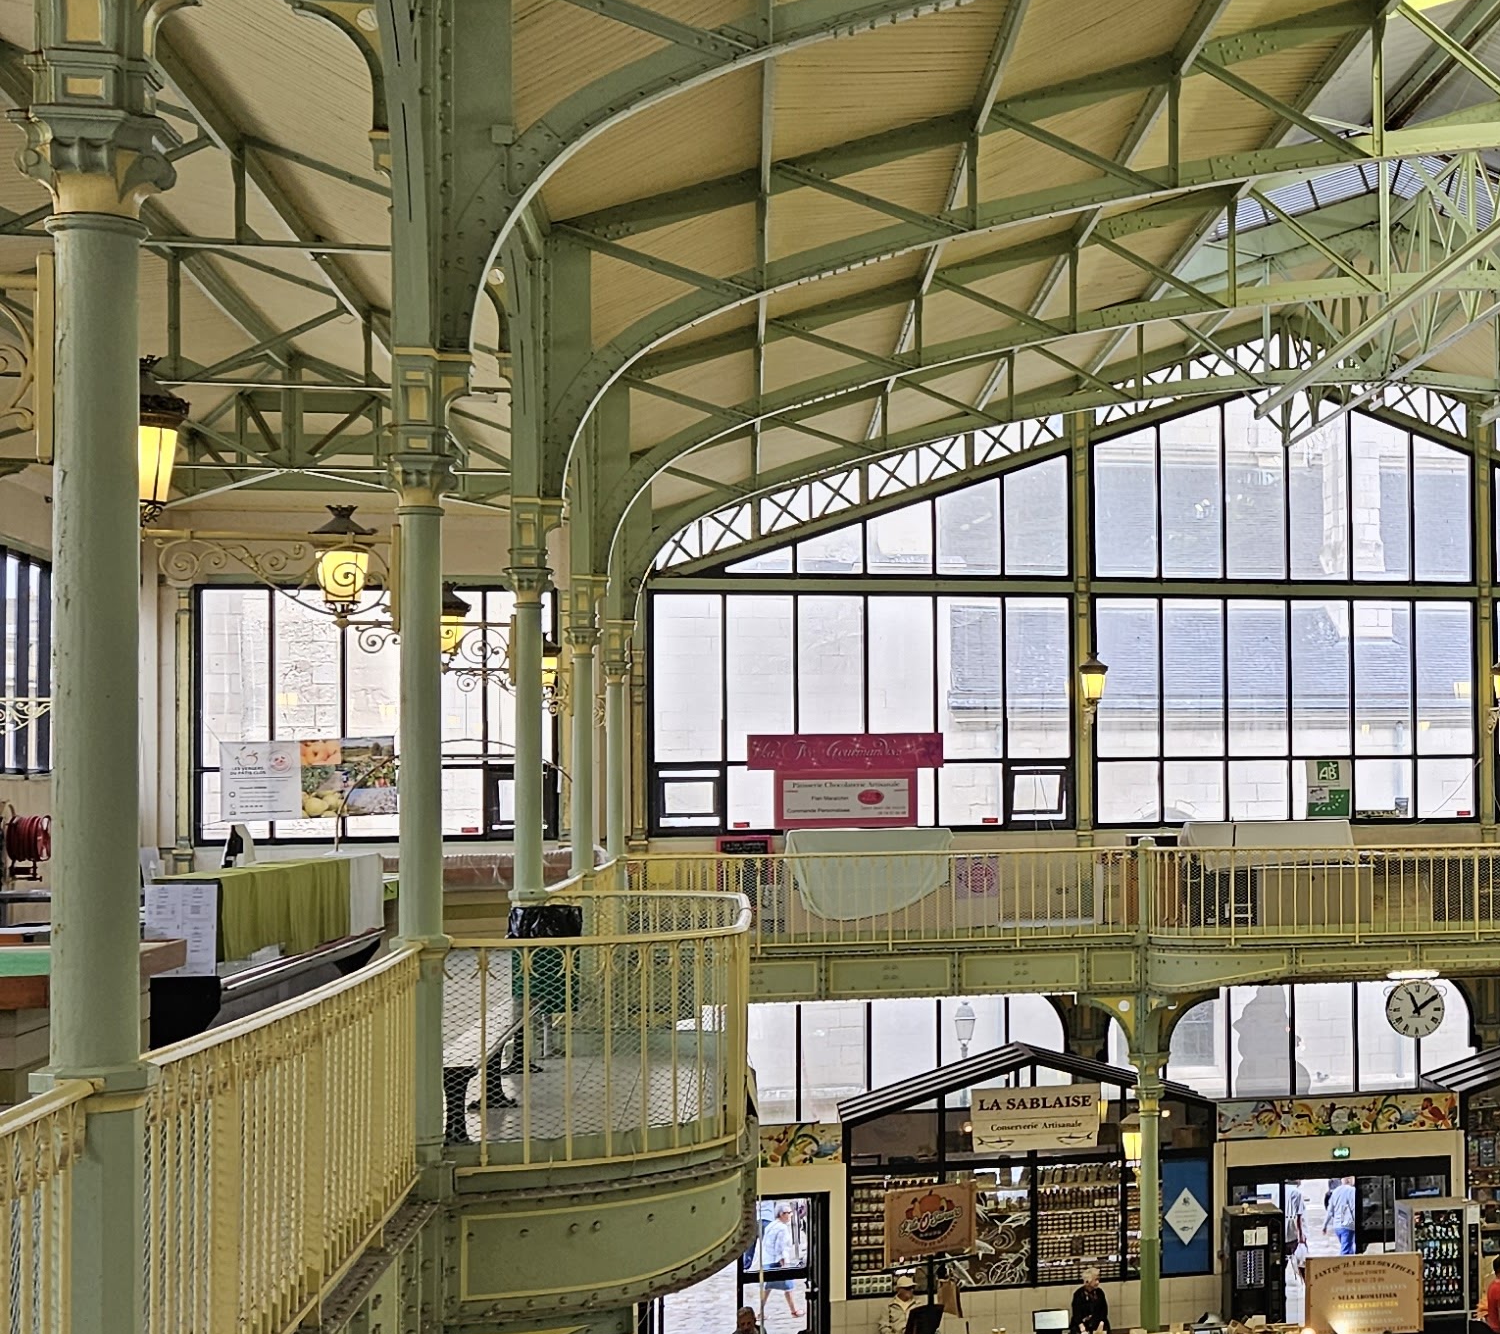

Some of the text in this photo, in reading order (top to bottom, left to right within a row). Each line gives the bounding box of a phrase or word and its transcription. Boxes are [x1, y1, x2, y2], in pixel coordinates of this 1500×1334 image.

[1319, 767, 1338, 780] AB
[978, 1095, 1092, 1111] LA SABLAISE
[991, 1120, 1082, 1132] Conserverie Artisanale
